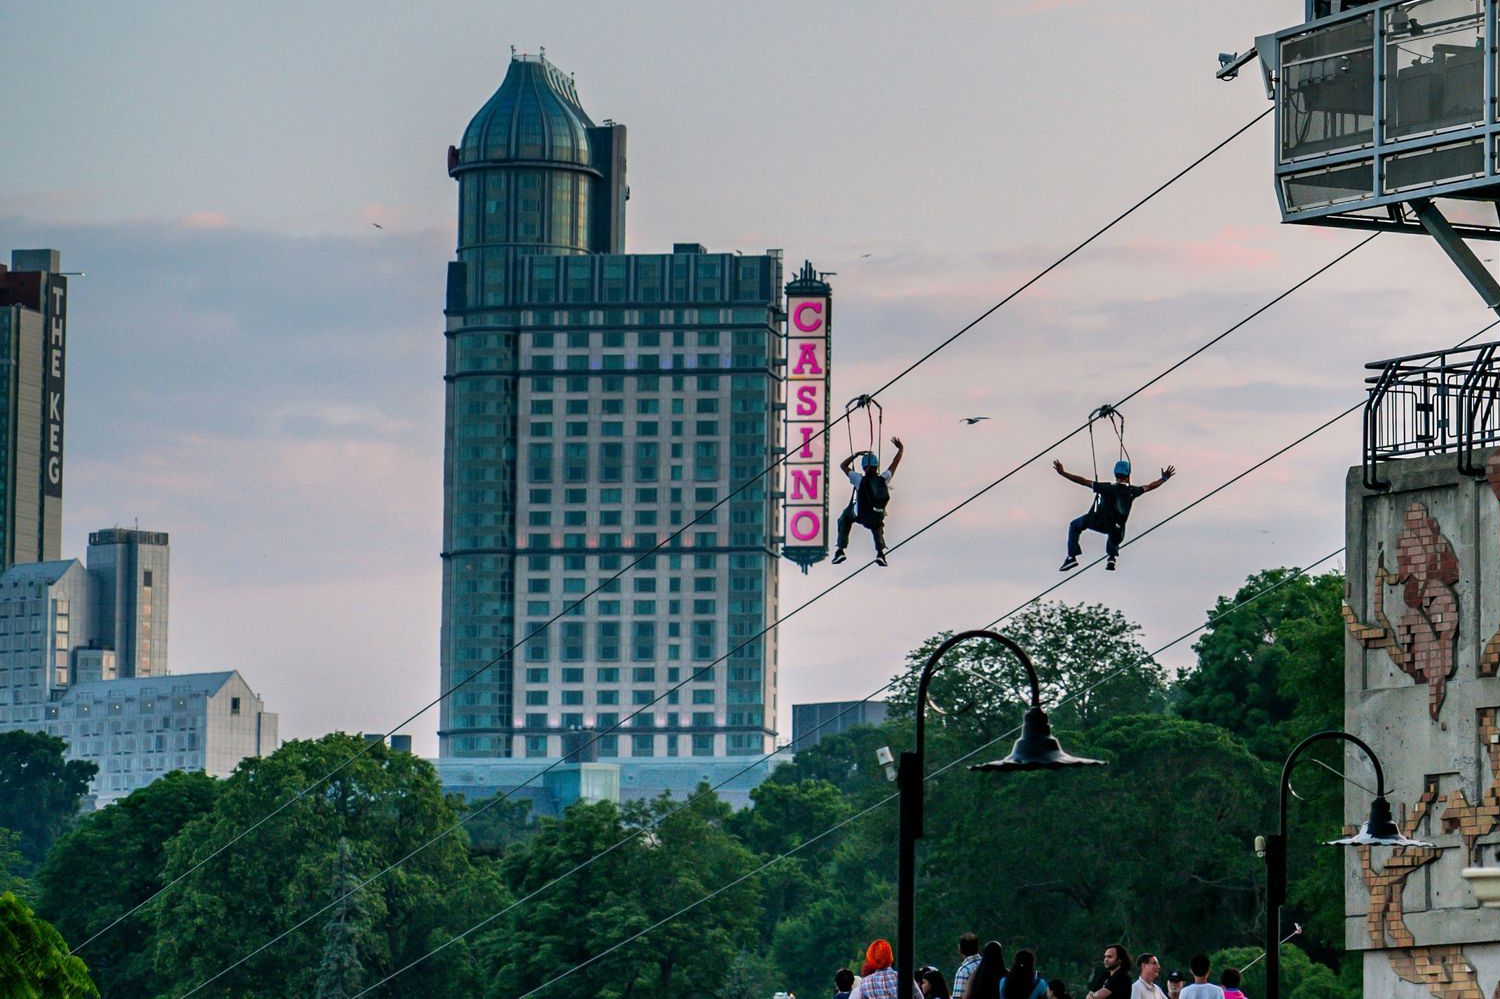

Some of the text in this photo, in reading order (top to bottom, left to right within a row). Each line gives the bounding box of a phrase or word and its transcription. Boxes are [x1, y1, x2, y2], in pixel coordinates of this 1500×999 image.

[48, 287, 64, 485] THE KEG
[791, 302, 822, 541] CASINO
